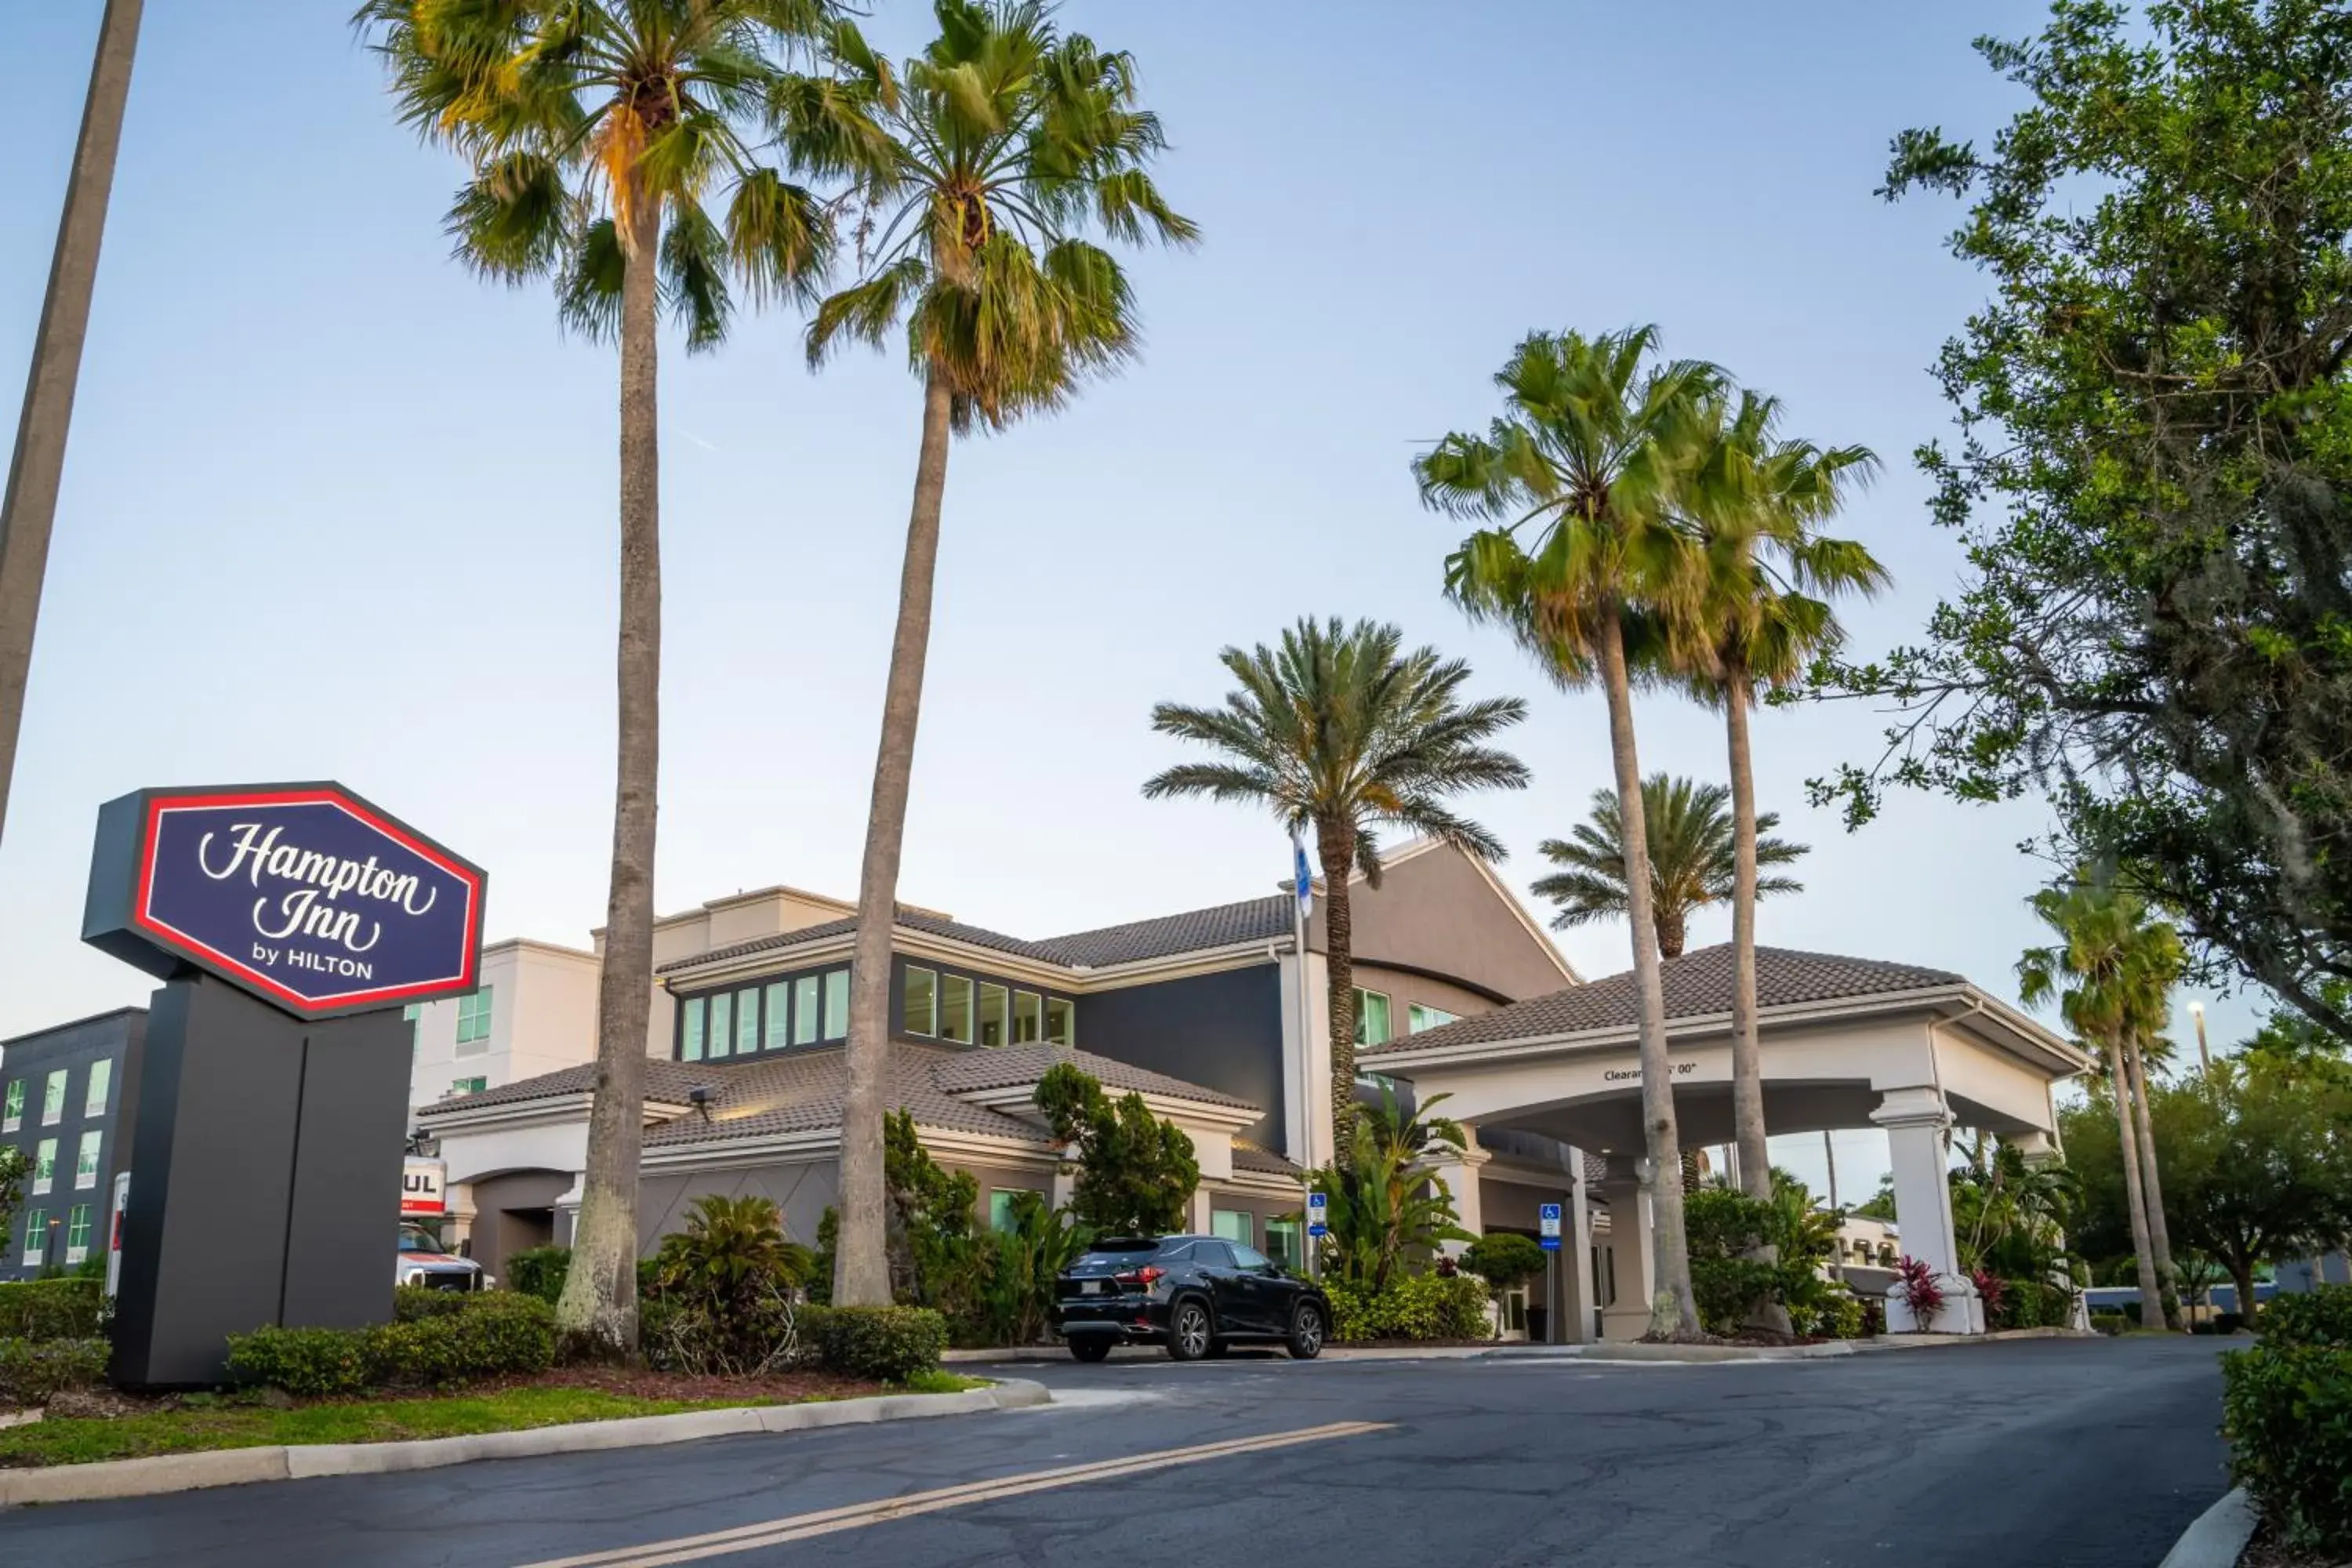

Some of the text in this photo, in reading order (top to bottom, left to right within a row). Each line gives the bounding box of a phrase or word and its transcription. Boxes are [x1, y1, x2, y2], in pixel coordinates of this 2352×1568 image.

[200, 824, 436, 914] Hampton
[253, 890, 380, 951] Inn
[252, 942, 372, 979] by HILTON
